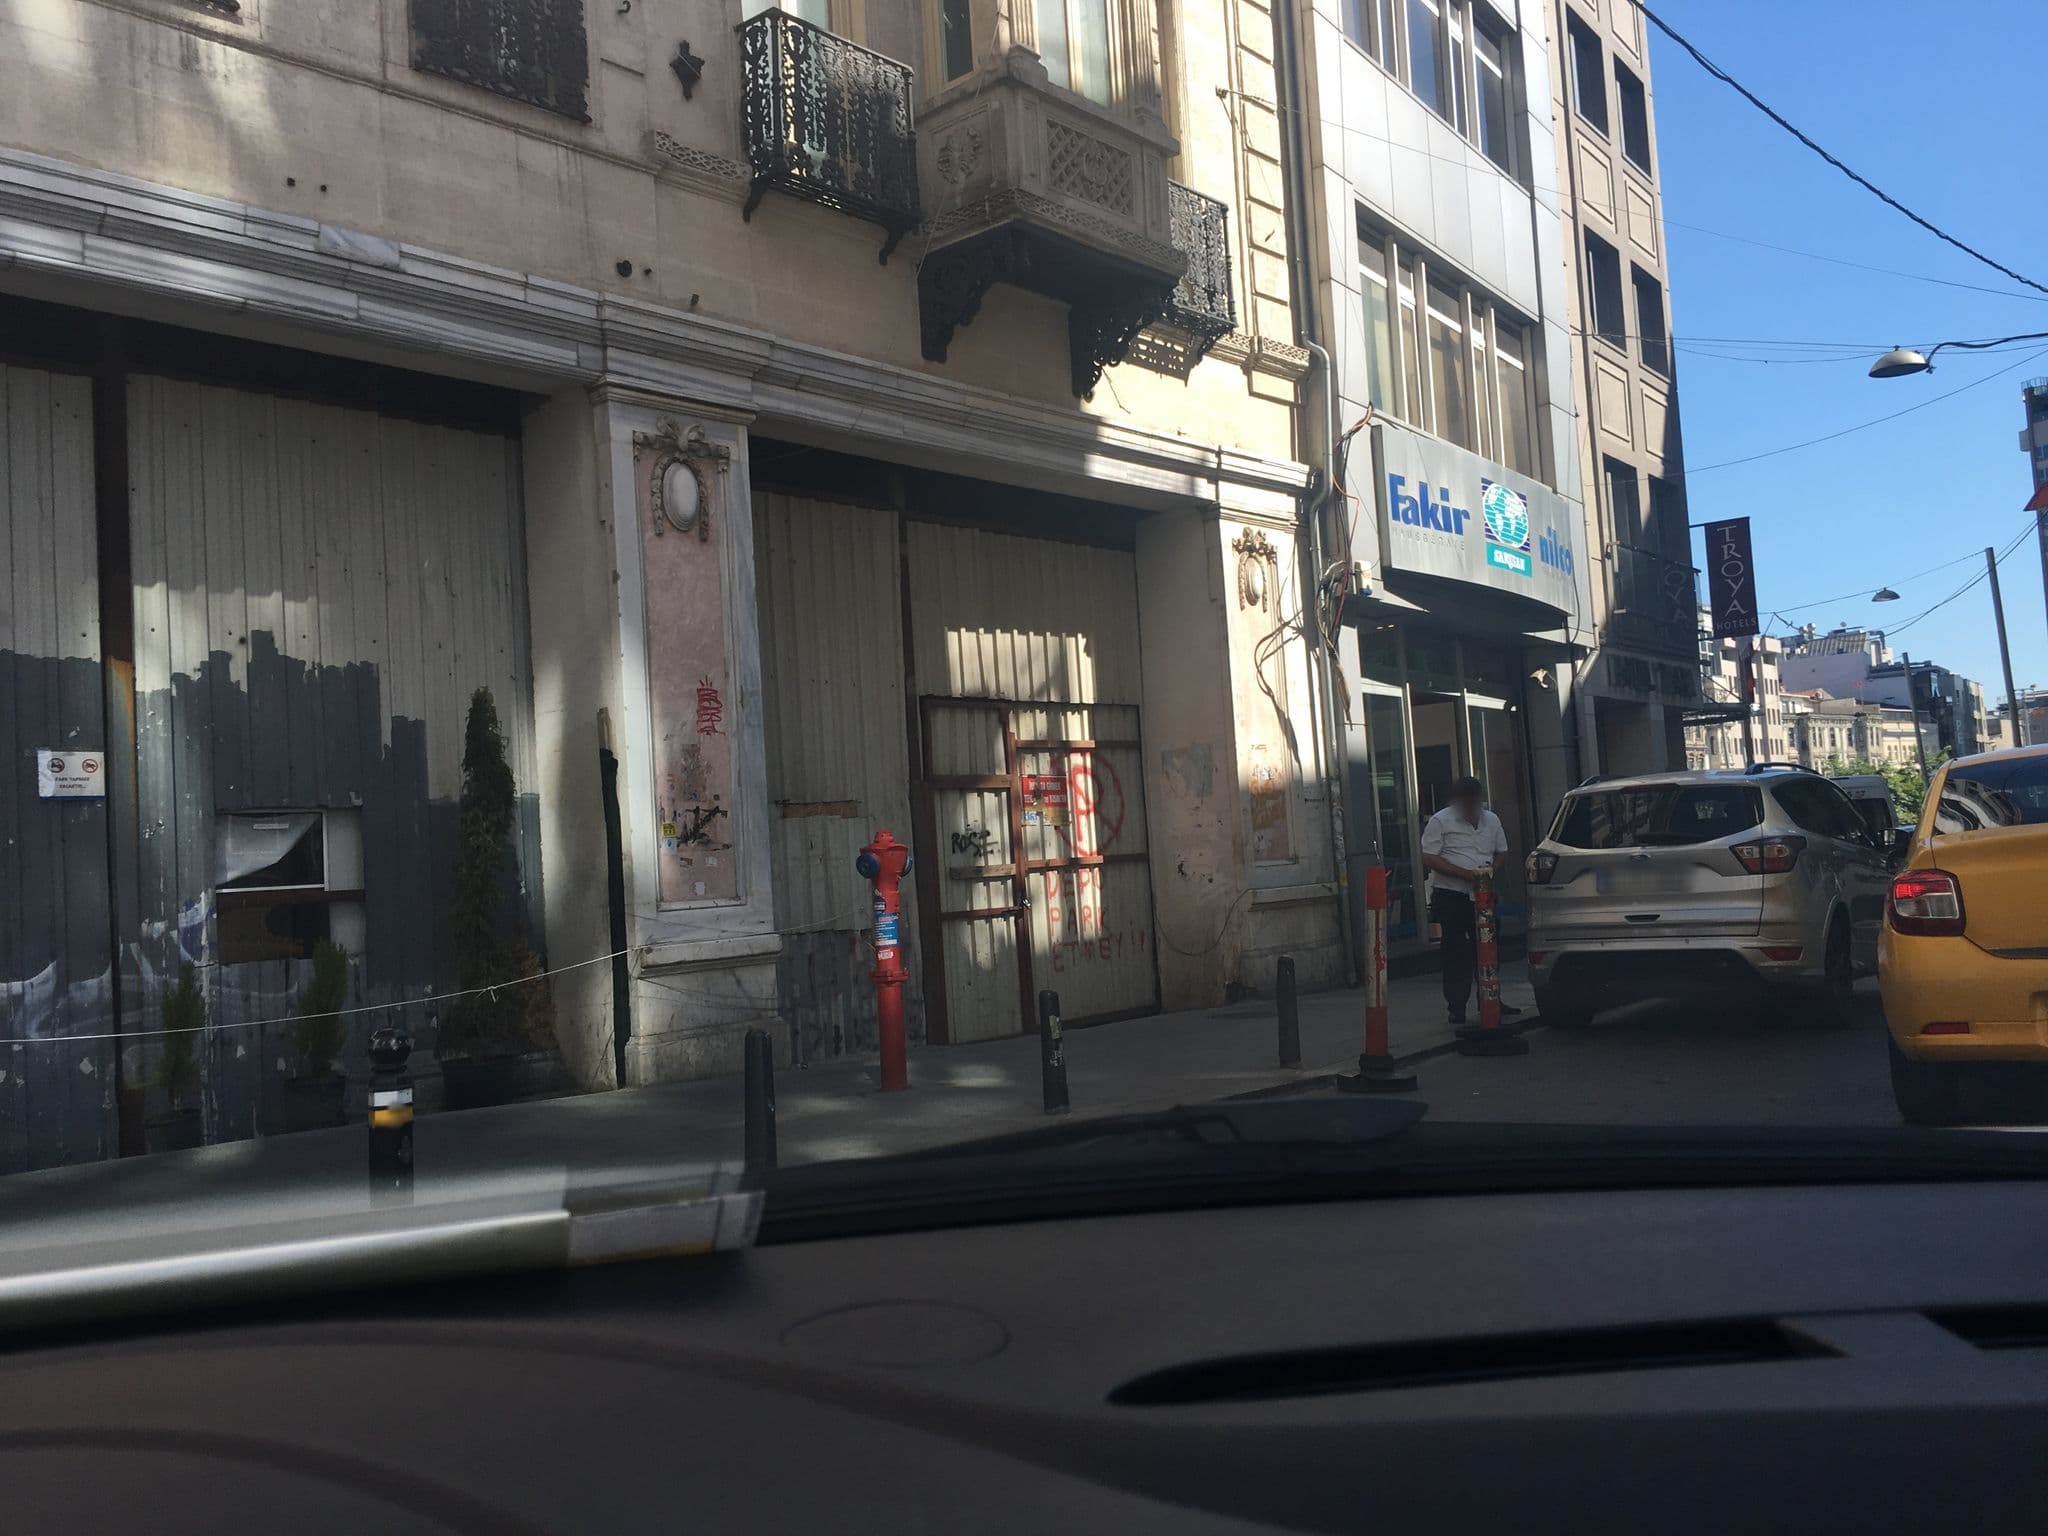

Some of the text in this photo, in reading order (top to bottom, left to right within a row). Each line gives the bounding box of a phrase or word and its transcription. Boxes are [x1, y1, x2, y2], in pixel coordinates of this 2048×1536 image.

[1389, 473, 1470, 536] Fakir
[1538, 526, 1573, 576] nilco
[1716, 525, 1749, 617] TROYA
[1715, 617, 1757, 632] HOTELS
